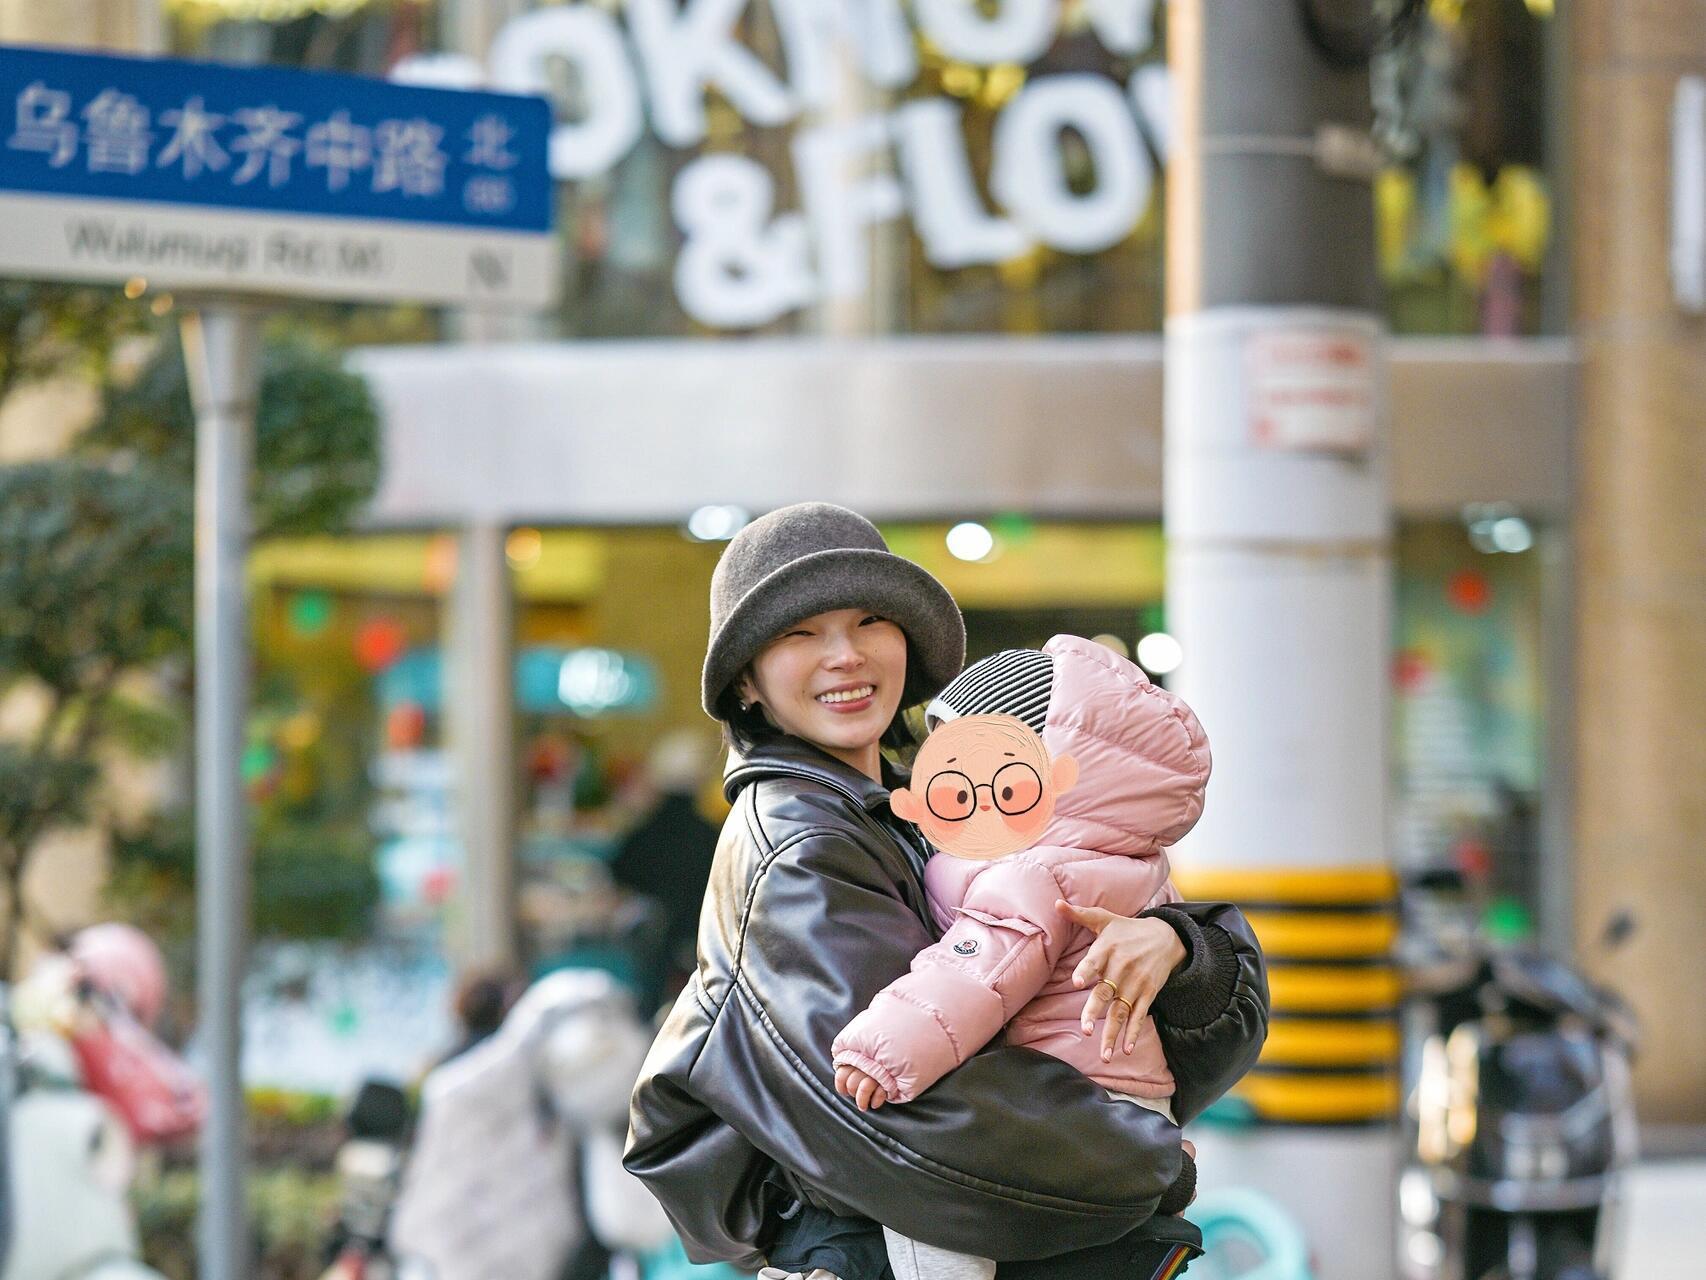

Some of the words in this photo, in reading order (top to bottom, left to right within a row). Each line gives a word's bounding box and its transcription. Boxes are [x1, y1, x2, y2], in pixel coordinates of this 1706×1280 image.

[8, 80, 448, 198] 乌鲁木齐中路
